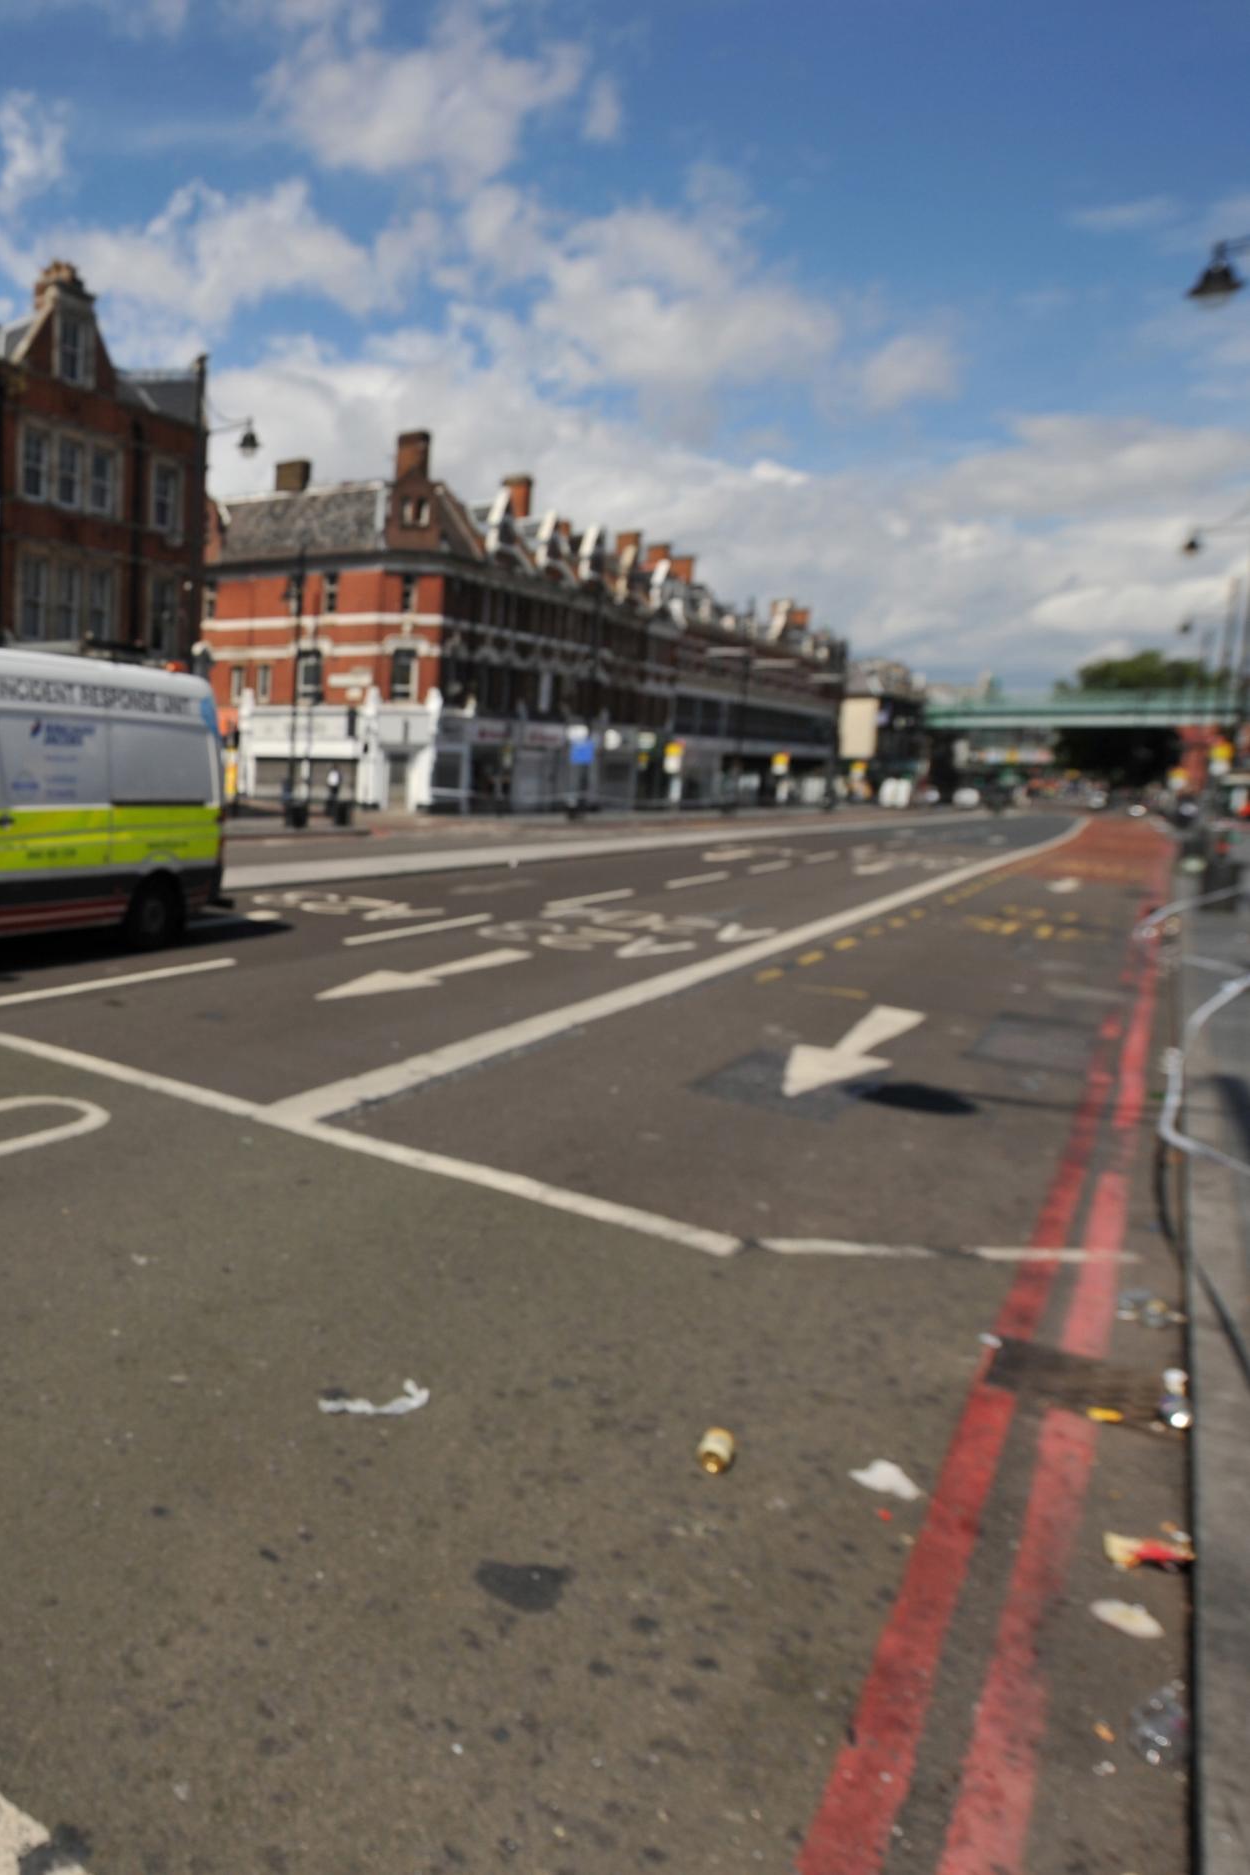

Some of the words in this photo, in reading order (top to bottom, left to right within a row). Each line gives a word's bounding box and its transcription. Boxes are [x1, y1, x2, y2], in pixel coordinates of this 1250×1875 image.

[0, 676, 76, 706] INCIDENT
[80, 684, 157, 714] RESPONSE
[161, 694, 193, 716] UNIT
